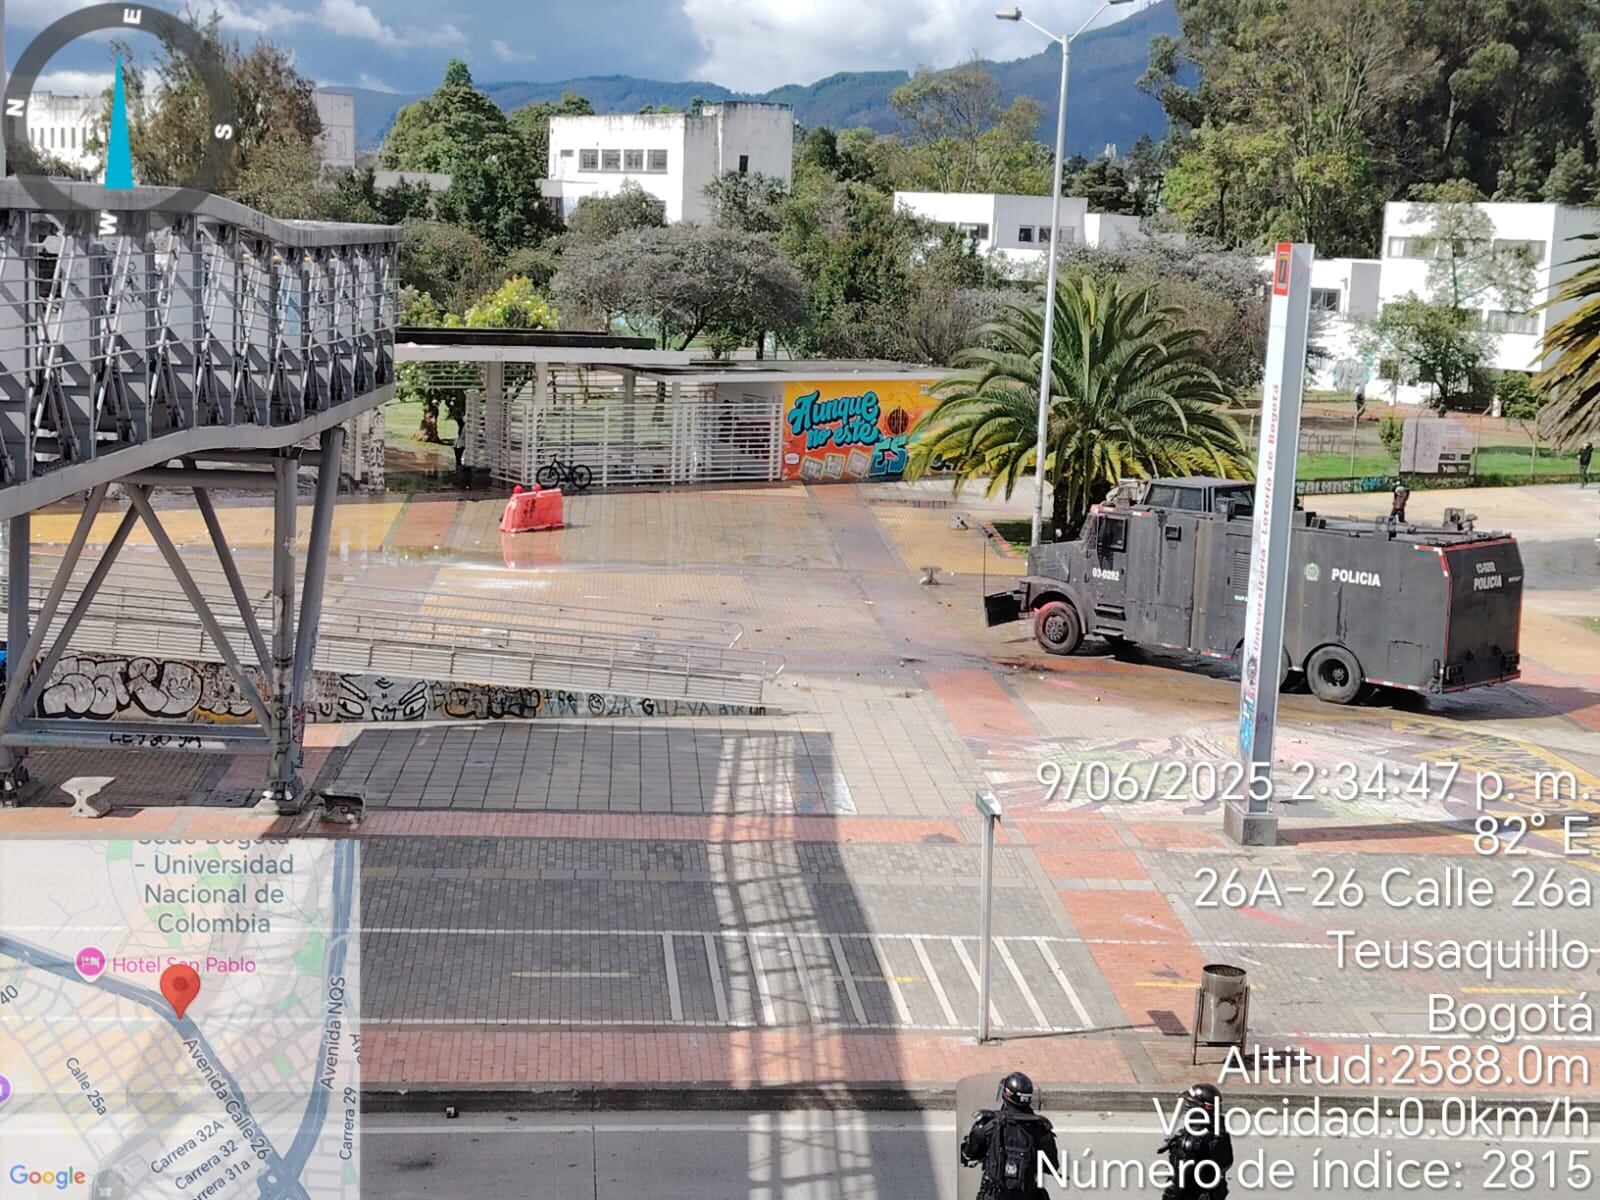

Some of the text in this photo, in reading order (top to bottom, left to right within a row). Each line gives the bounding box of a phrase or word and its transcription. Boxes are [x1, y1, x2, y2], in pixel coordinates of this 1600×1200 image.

[788, 390, 880, 436] Aunque
[806, 428, 832, 450] no
[1266, 449, 1275, 471] de
[1332, 568, 1382, 588] POLICIA
